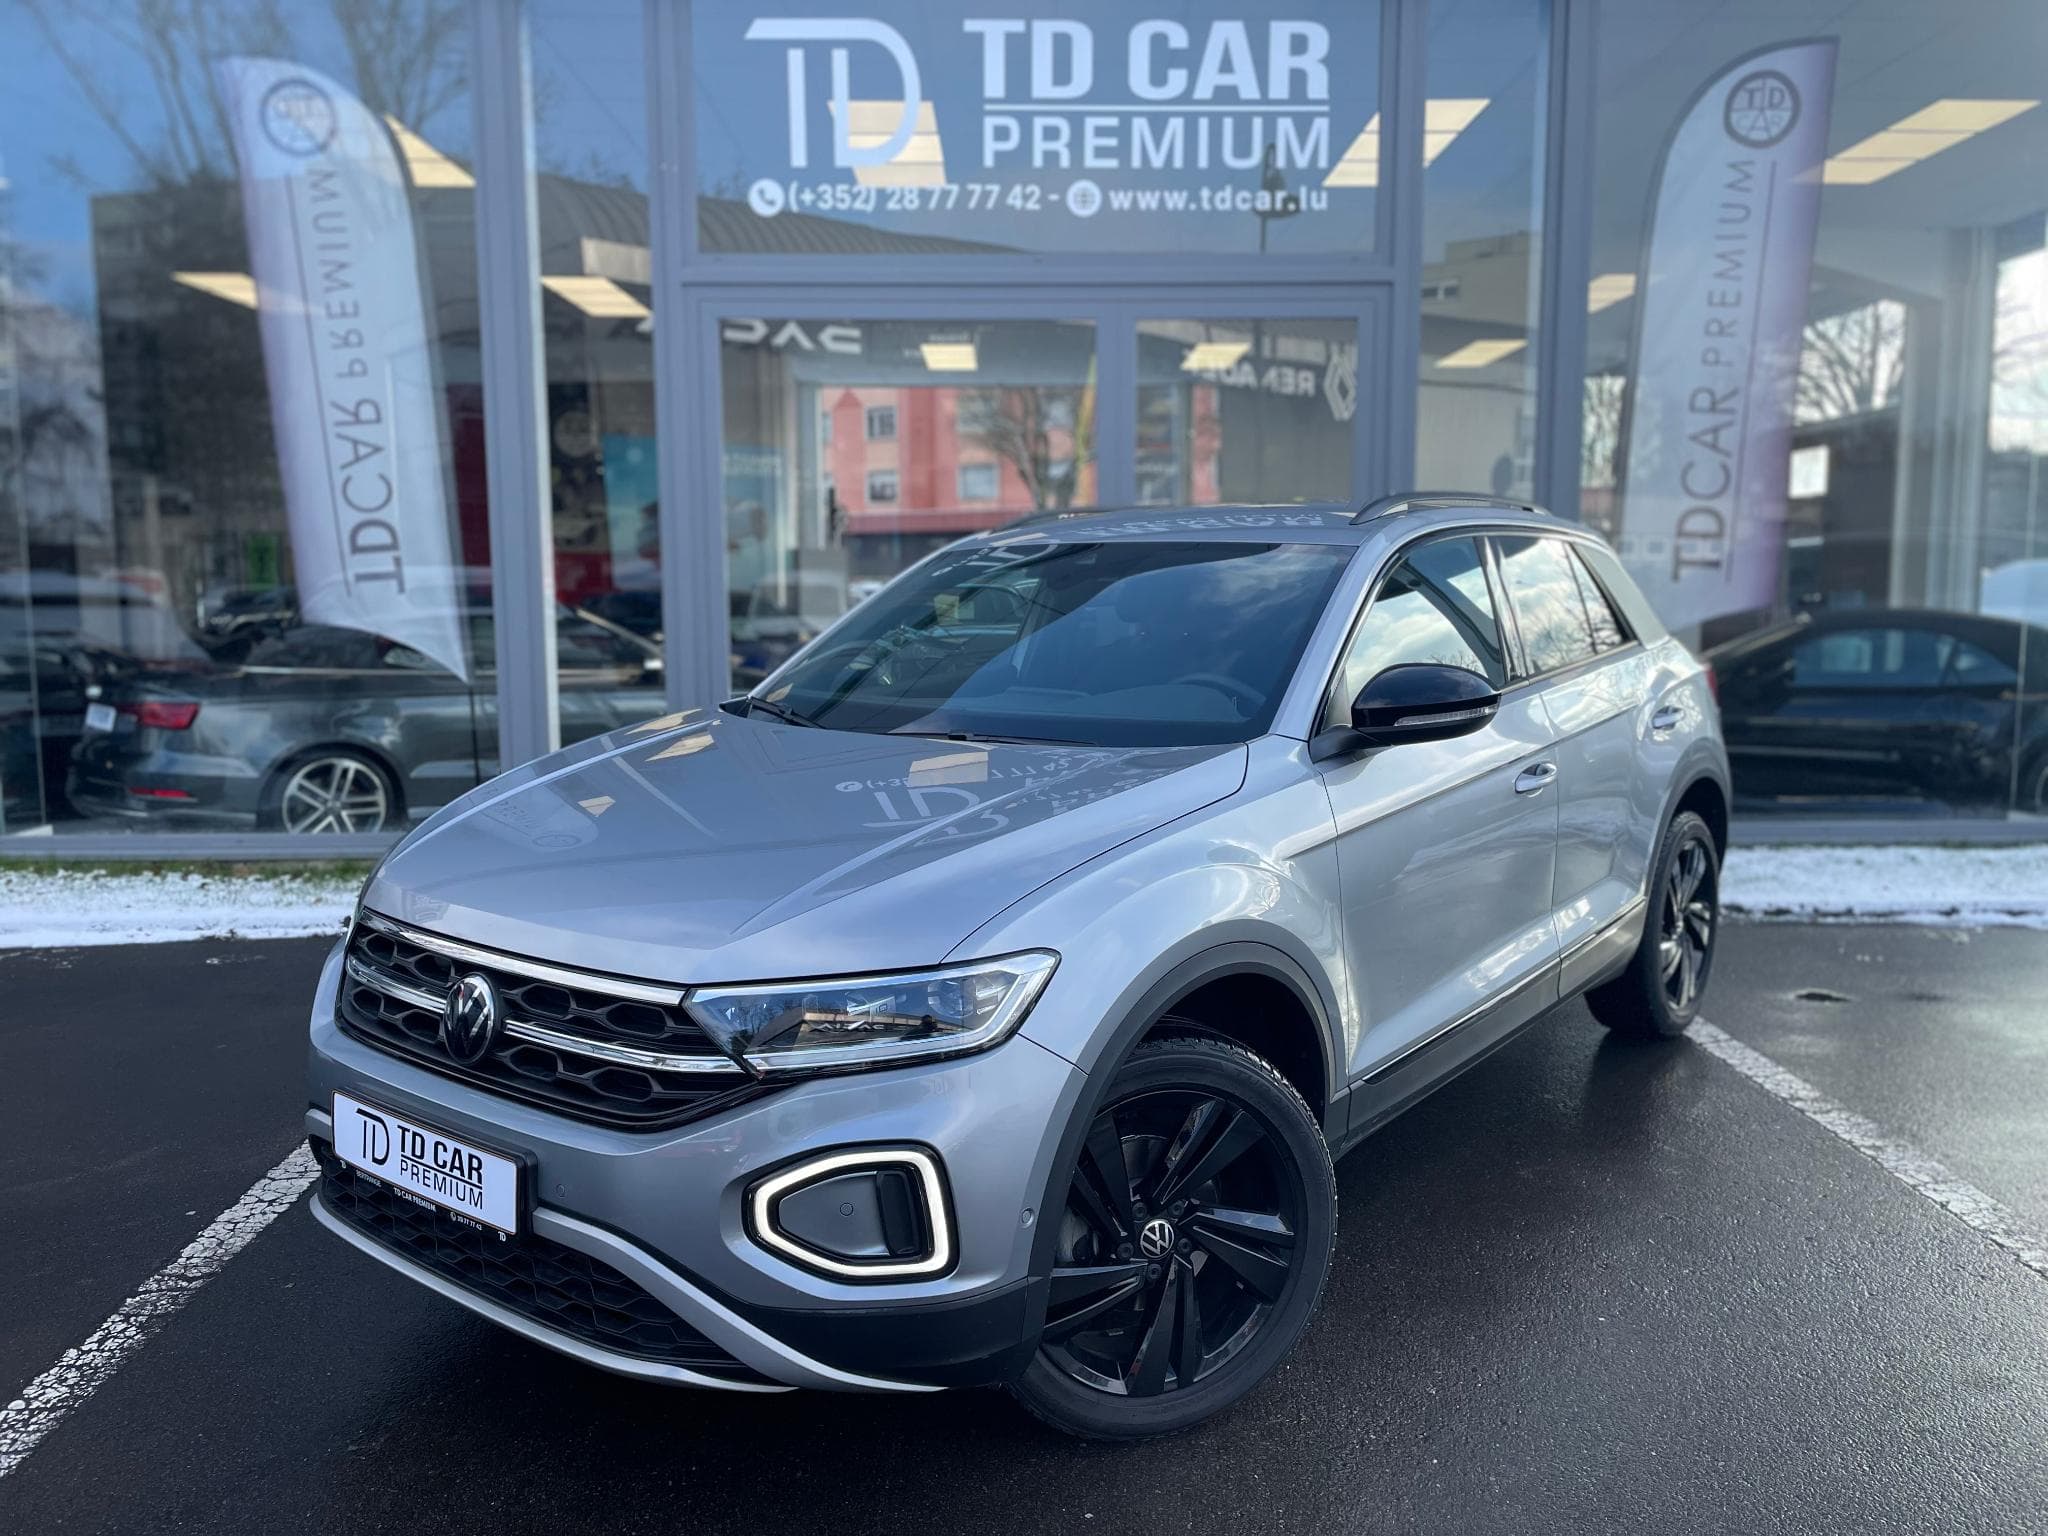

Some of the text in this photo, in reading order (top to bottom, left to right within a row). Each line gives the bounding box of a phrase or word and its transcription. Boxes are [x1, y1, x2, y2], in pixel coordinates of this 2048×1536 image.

[964, 19, 1330, 100] TD CAR
[744, 18, 921, 168] TD
[983, 117, 1329, 169] PREMIUM
[788, 181, 877, 212] (+352)
[885, 185, 919, 211] 28
[927, 185, 960, 211] 77
[966, 185, 1000, 211] 77
[1005, 184, 1041, 211] 42
[1108, 184, 1329, 212] www.tdcar.lu
[1701, 160, 1754, 368] PREMIUM
[356, 1108, 390, 1166] TD
[397, 1125, 483, 1185] TD CAR
[400, 1159, 483, 1210] PREMIUM
[497, 1231, 507, 1242] TD
